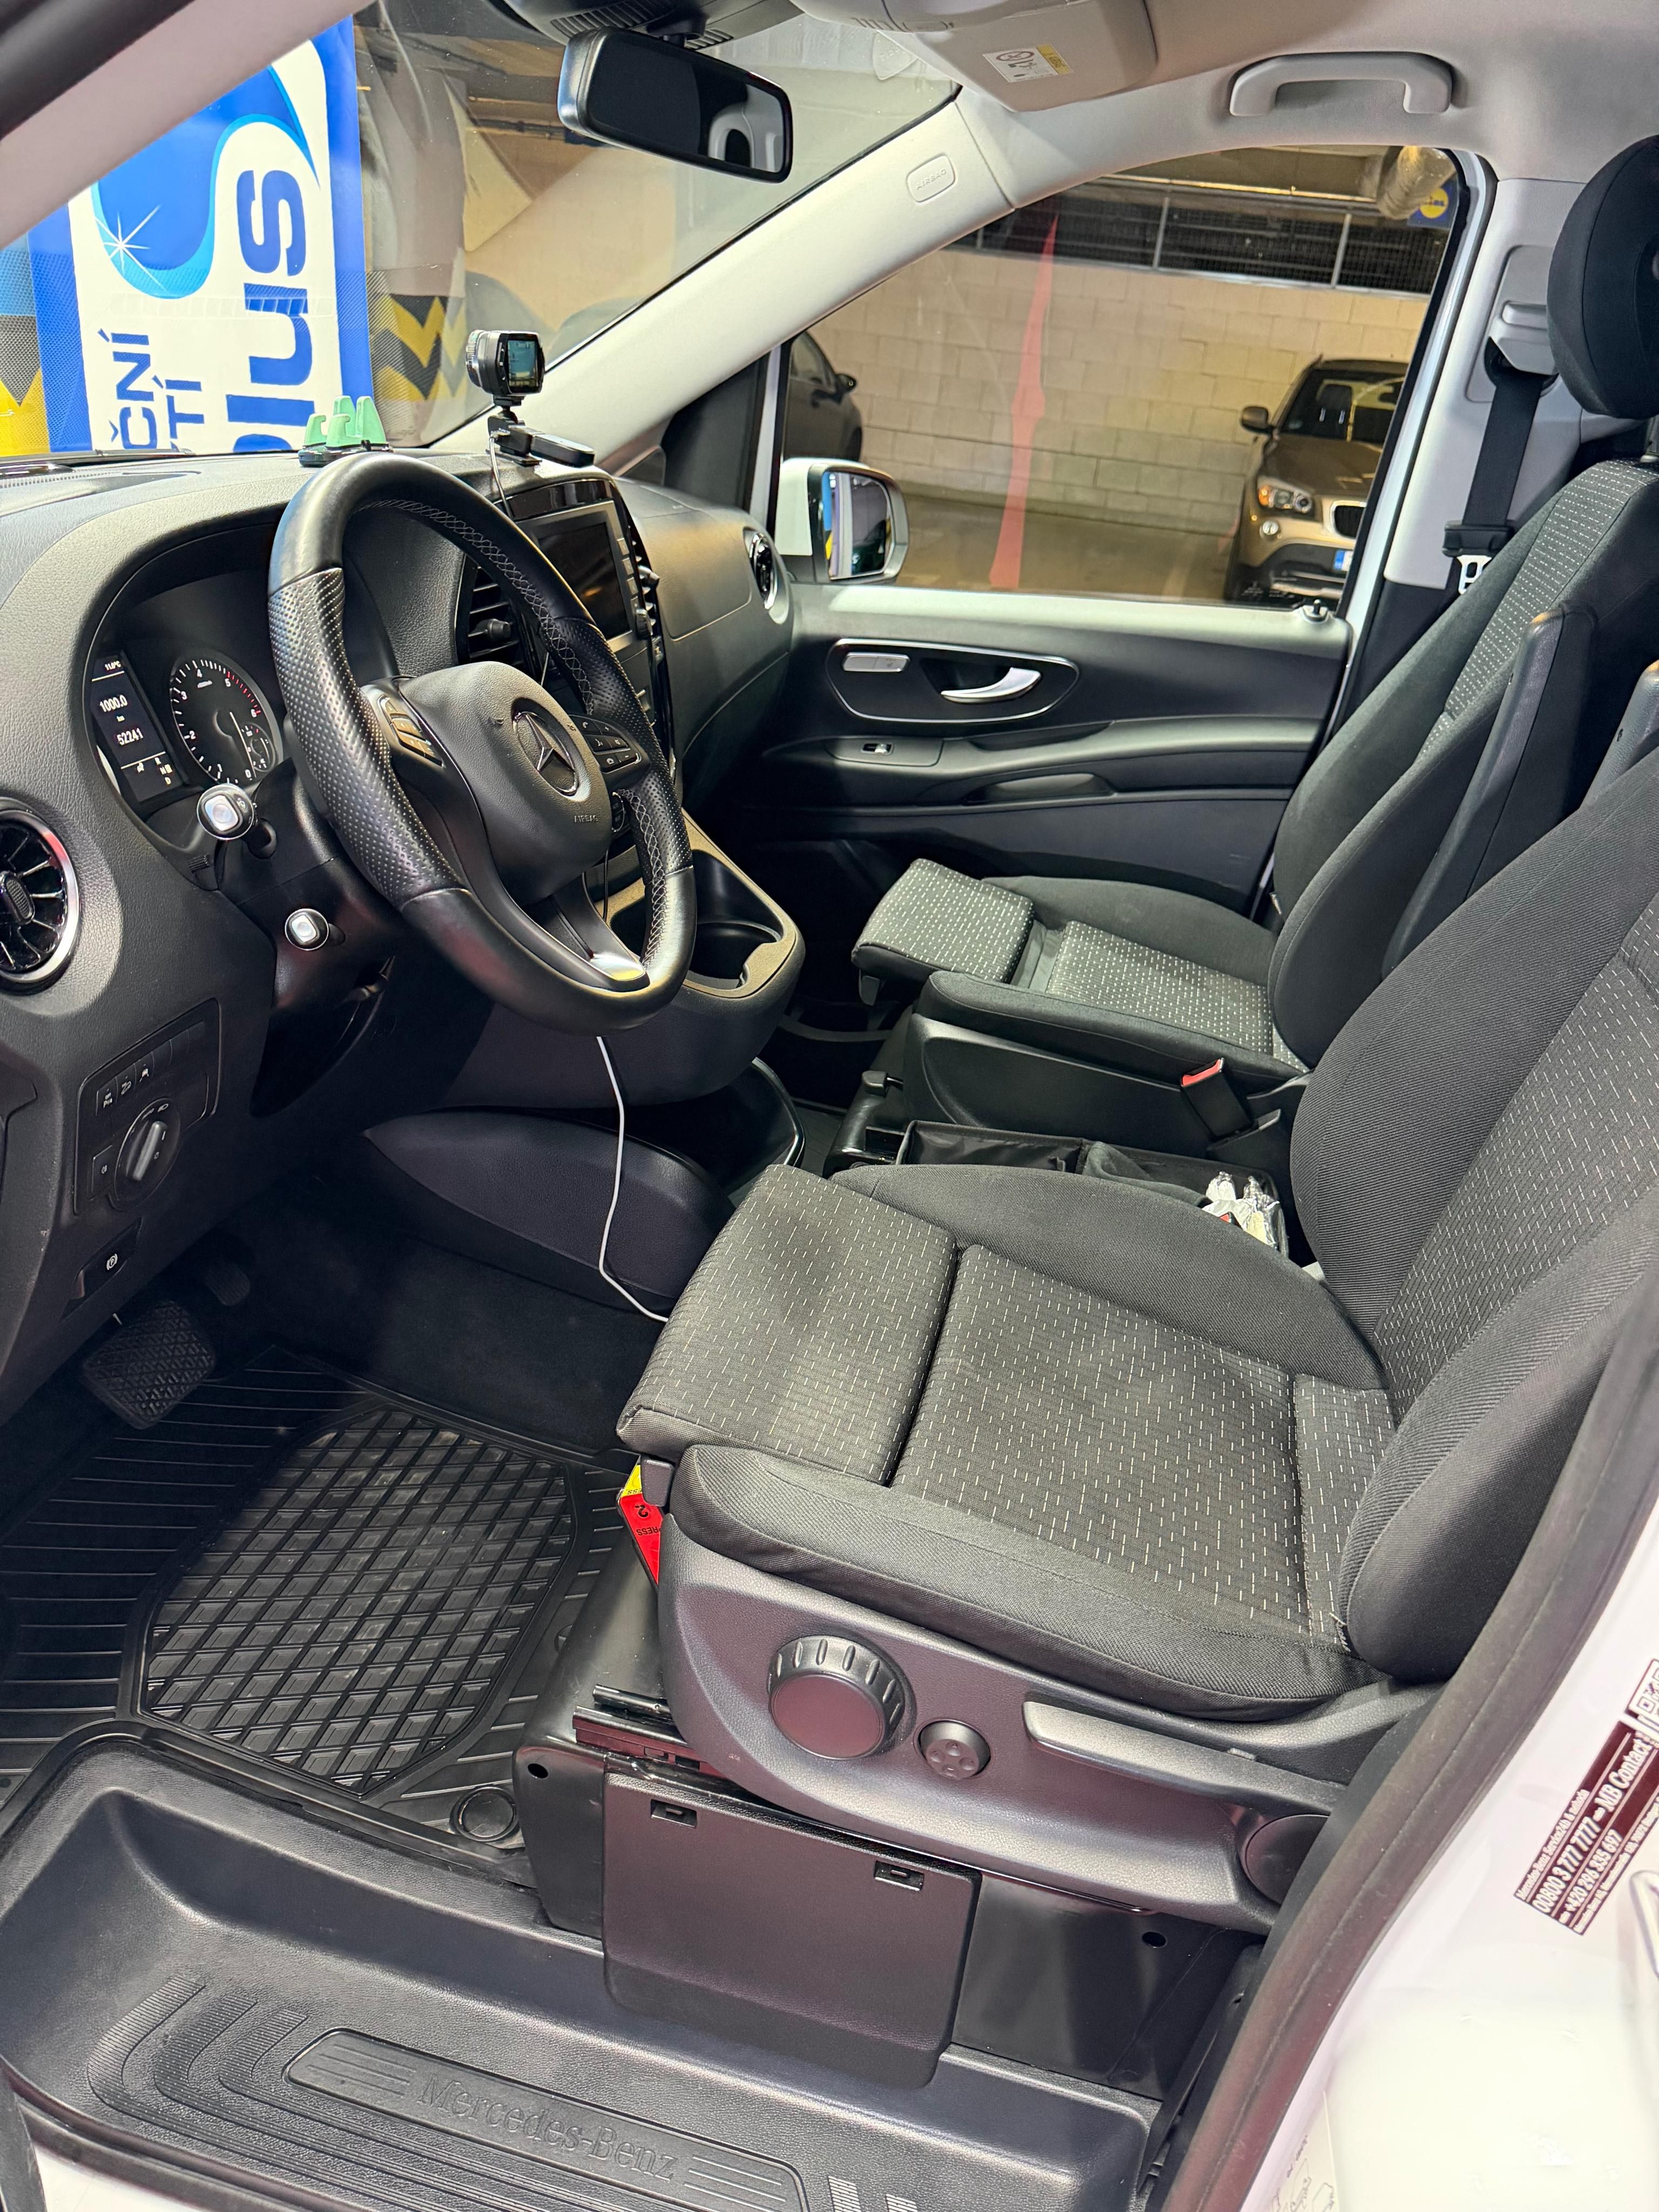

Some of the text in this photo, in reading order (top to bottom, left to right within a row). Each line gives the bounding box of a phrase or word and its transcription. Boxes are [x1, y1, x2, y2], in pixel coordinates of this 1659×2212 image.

[226, 170, 315, 453] lus
[151, 375, 205, 453] TÍ
[181, 691, 187, 700] 3
[225, 678, 231, 687] 5
[100, 694, 128, 712] 1000.0
[117, 727, 144, 746] 52241
[190, 730, 196, 739] 2
[1608, 1738, 1653, 1790] Contact
[1594, 1784, 1623, 1813] MB
[1569, 1816, 1601, 1852] 7777
[1552, 1866, 1571, 1881] 3
[1557, 1845, 1583, 1873] 777
[1564, 1883, 1586, 1912] +420
[1577, 1865, 1600, 1891] 296
[1589, 1848, 1611, 1873] 335
[1601, 1829, 1623, 1853] 697
[1532, 1874, 1566, 1913] 00800
[417, 2077, 678, 2182] Mercedes-Benz
